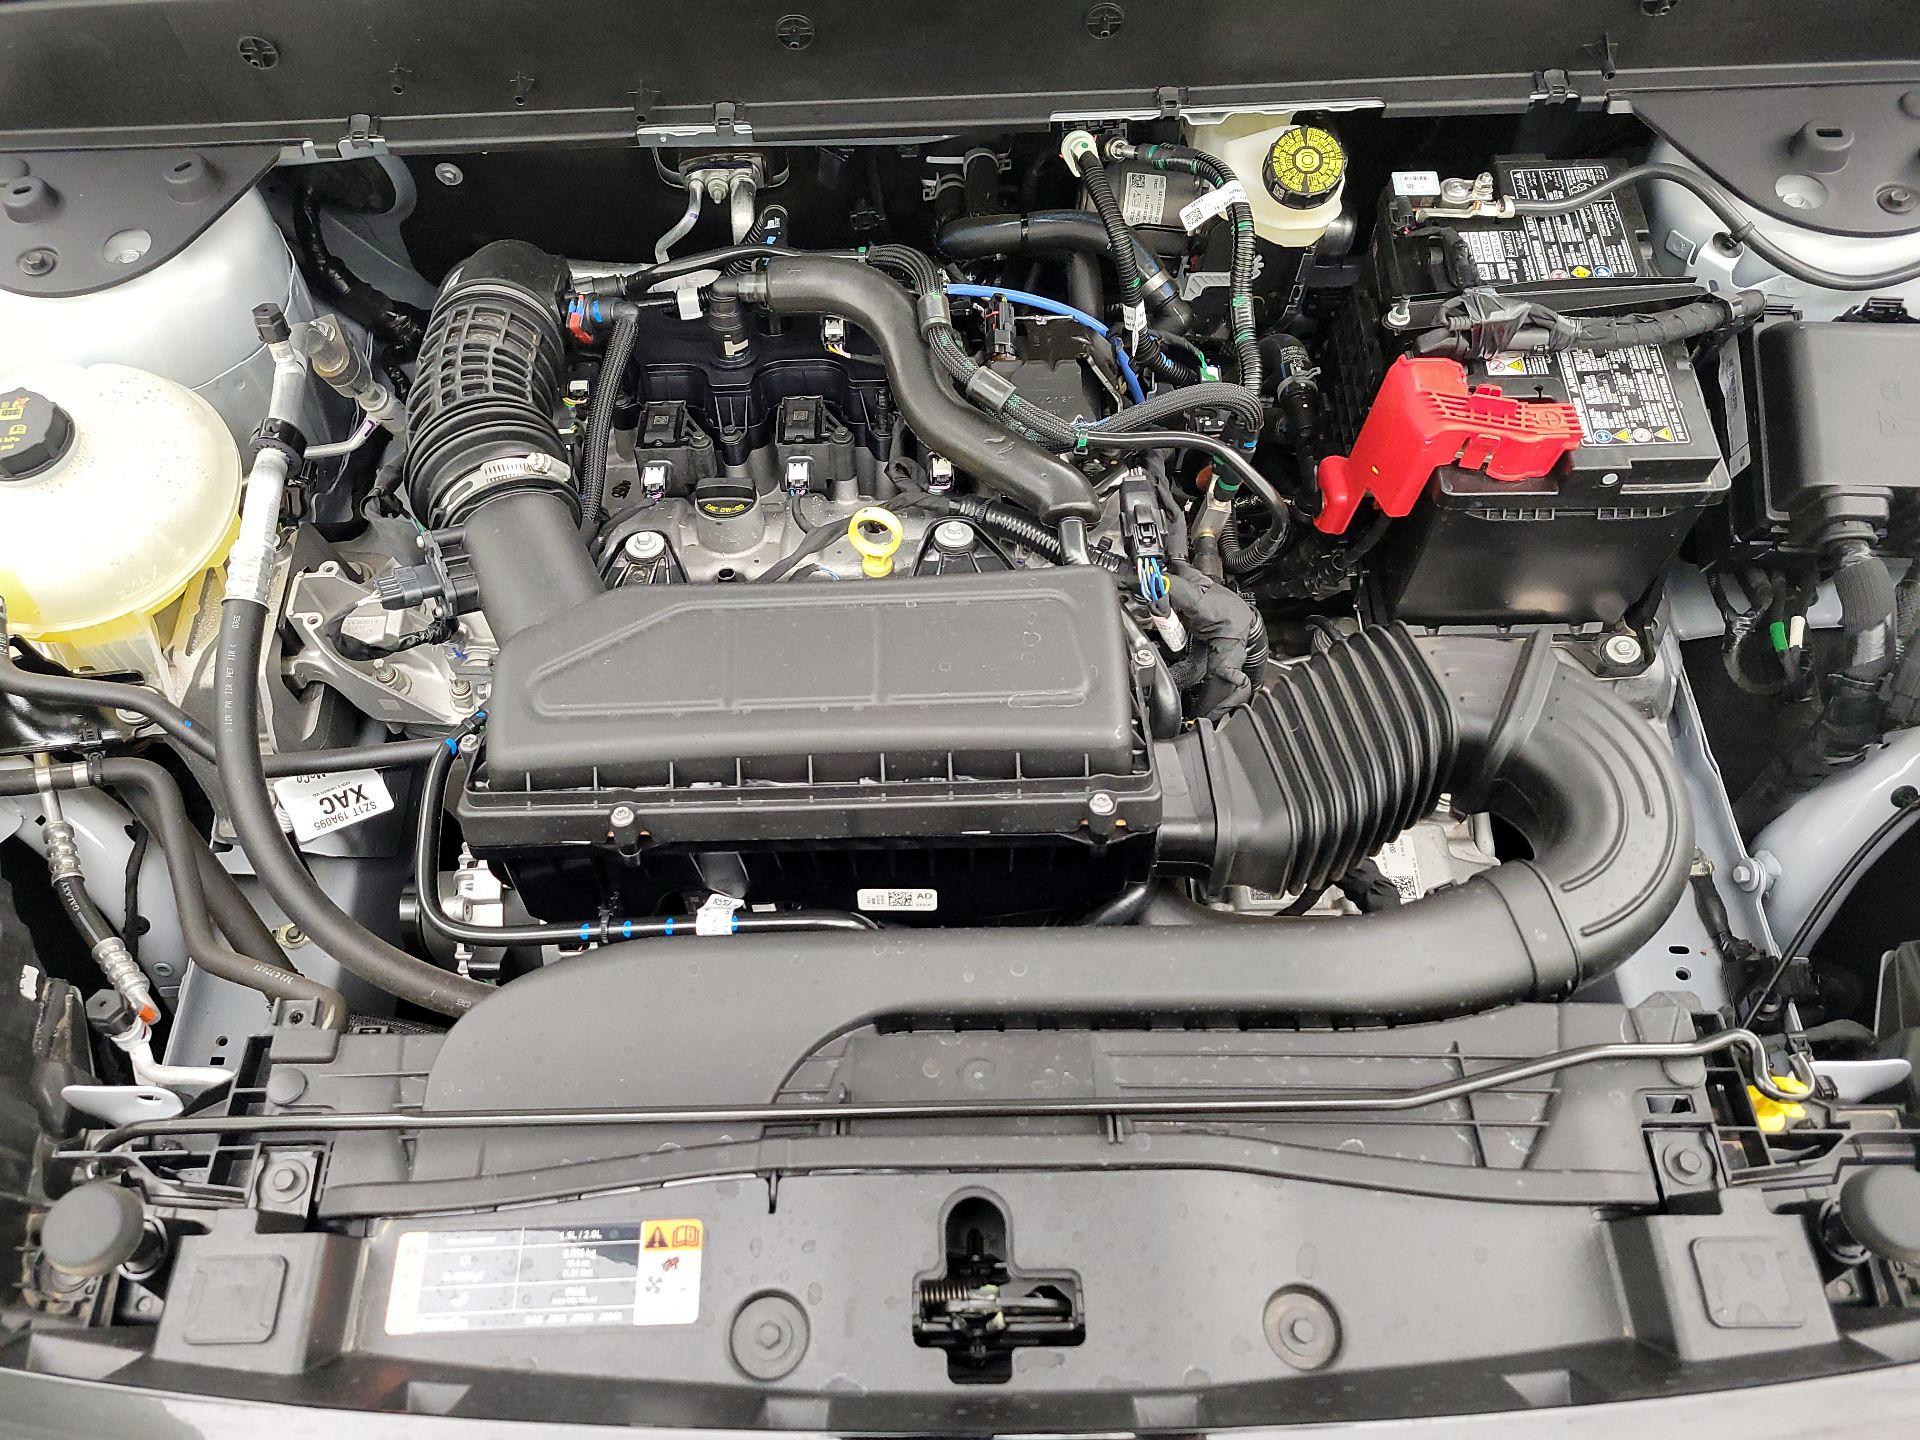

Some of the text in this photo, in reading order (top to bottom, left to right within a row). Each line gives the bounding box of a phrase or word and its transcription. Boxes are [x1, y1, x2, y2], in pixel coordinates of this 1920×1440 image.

[1502, 232, 1515, 255] FoMoCo
[704, 503, 745, 513] SAE 0W-20
[318, 784, 369, 815] XAC
[313, 801, 377, 831] SZ1T 19A095
[916, 892, 933, 900] AD
